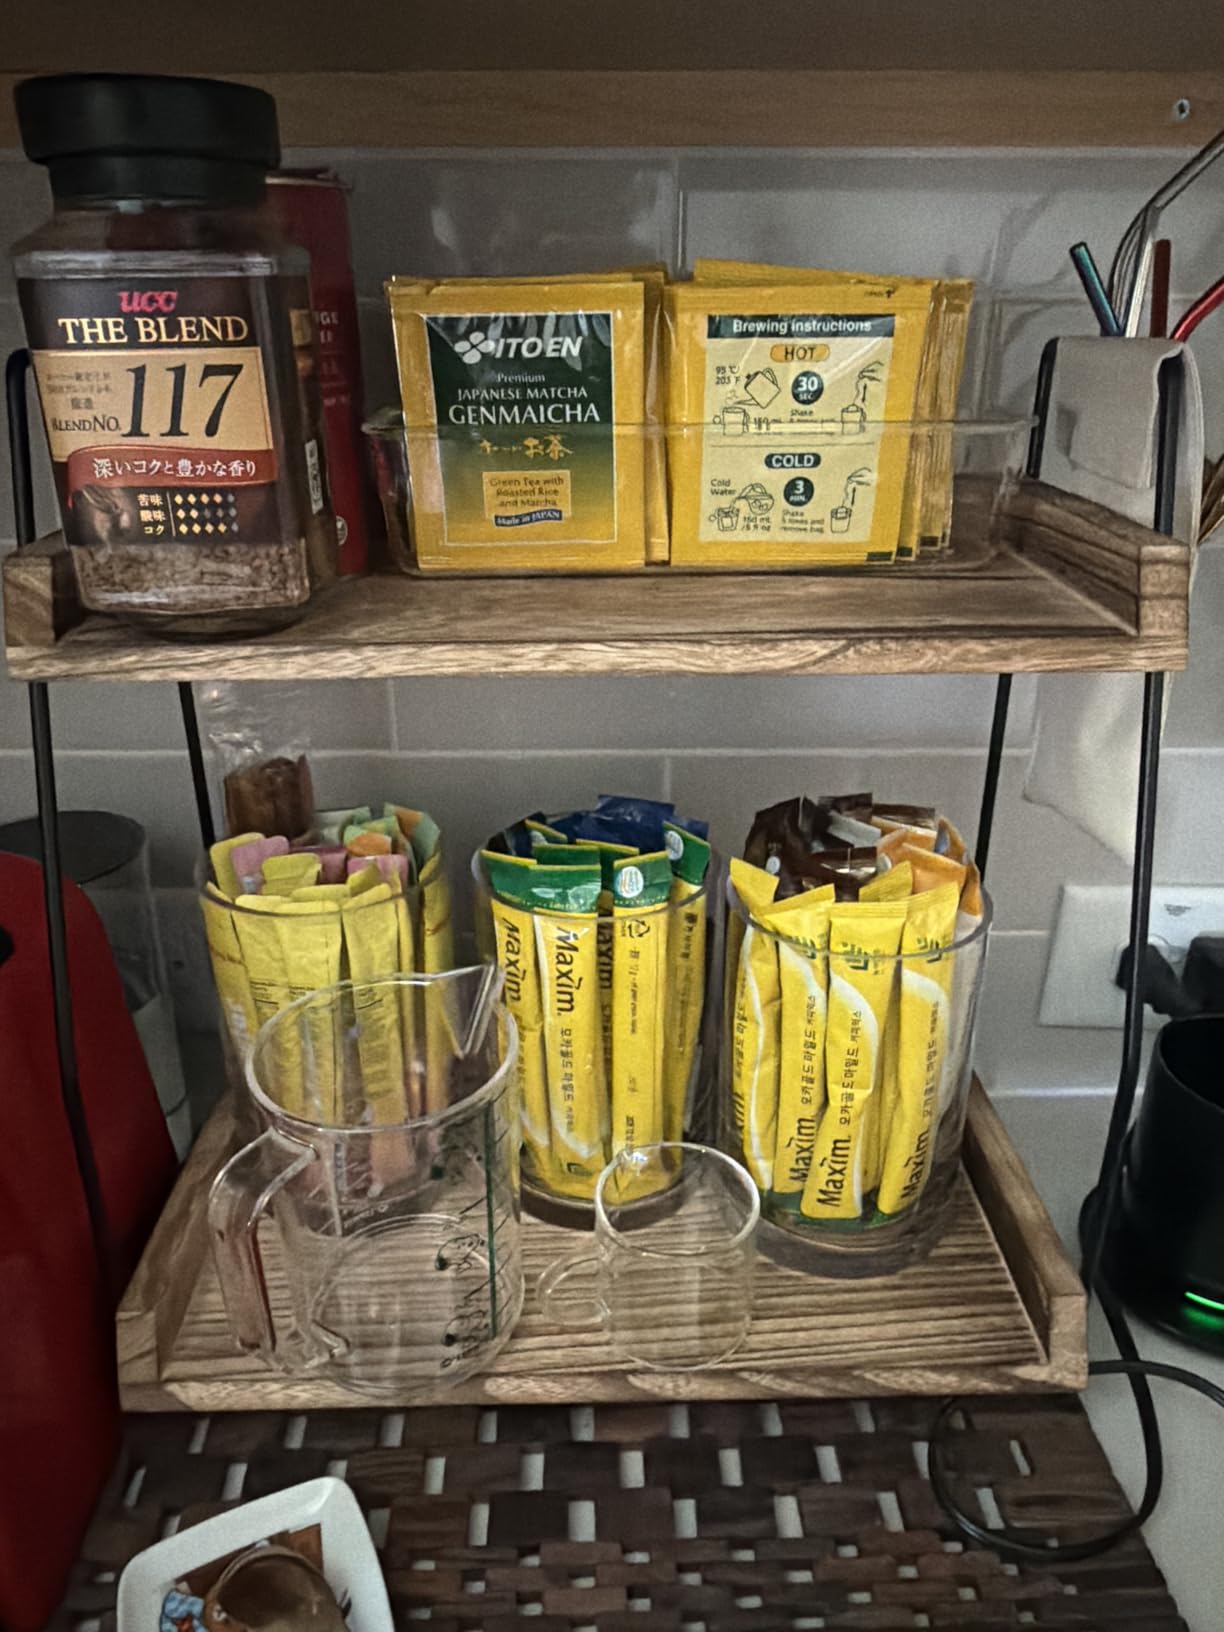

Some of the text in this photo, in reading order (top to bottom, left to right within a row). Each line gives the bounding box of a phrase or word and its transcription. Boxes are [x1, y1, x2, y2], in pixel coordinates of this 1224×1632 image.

[58, 315, 248, 344] THE BLEND
[732, 319, 788, 335] Brewing
[494, 336, 583, 359] ITO EN
[784, 346, 816, 361] HOT
[496, 372, 546, 383] Premium
[797, 376, 818, 391] 30
[121, 363, 245, 438] 117
[457, 386, 588, 401] JAPANESE MATCHA
[448, 402, 601, 425] GENMAICHA
[92, 457, 257, 480] 深いコクと豊かな香り
[771, 454, 815, 468] COLD
[710, 478, 730, 488] Cold
[794, 480, 805, 495] 3
[710, 487, 737, 497] Water
[143, 525, 165, 536] コク
[502, 917, 528, 1001] Maxim
[556, 926, 584, 1013] Maxim
[900, 1127, 930, 1199] Maxim
[816, 1137, 851, 1207] Maxim
